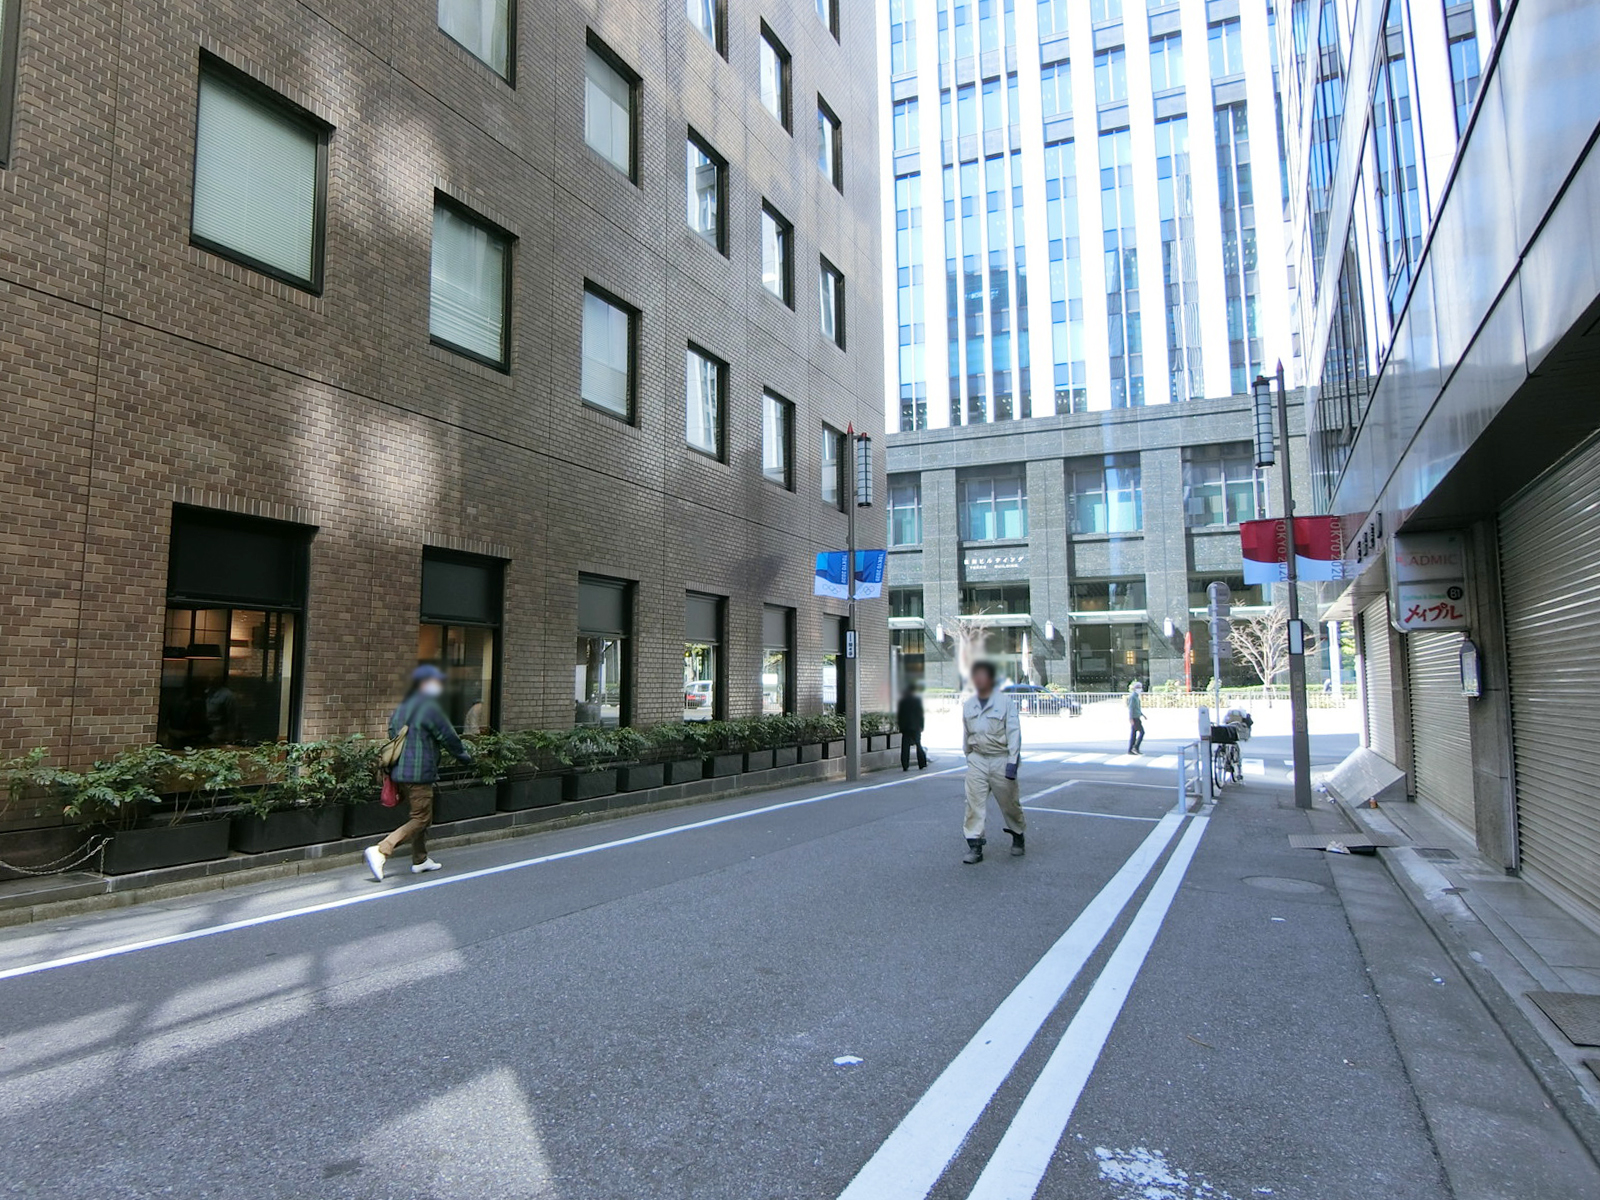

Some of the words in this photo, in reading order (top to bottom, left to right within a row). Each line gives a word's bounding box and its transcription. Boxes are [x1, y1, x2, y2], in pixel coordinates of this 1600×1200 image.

[1275, 519, 1287, 554] TOKYO
[1330, 517, 1341, 551] TOKYO
[876, 553, 884, 569] TOKYO
[1278, 556, 1288, 582] 2020
[1331, 554, 1343, 580] 2020
[1409, 554, 1458, 566] ADMIC
[1450, 588, 1461, 599] B1
